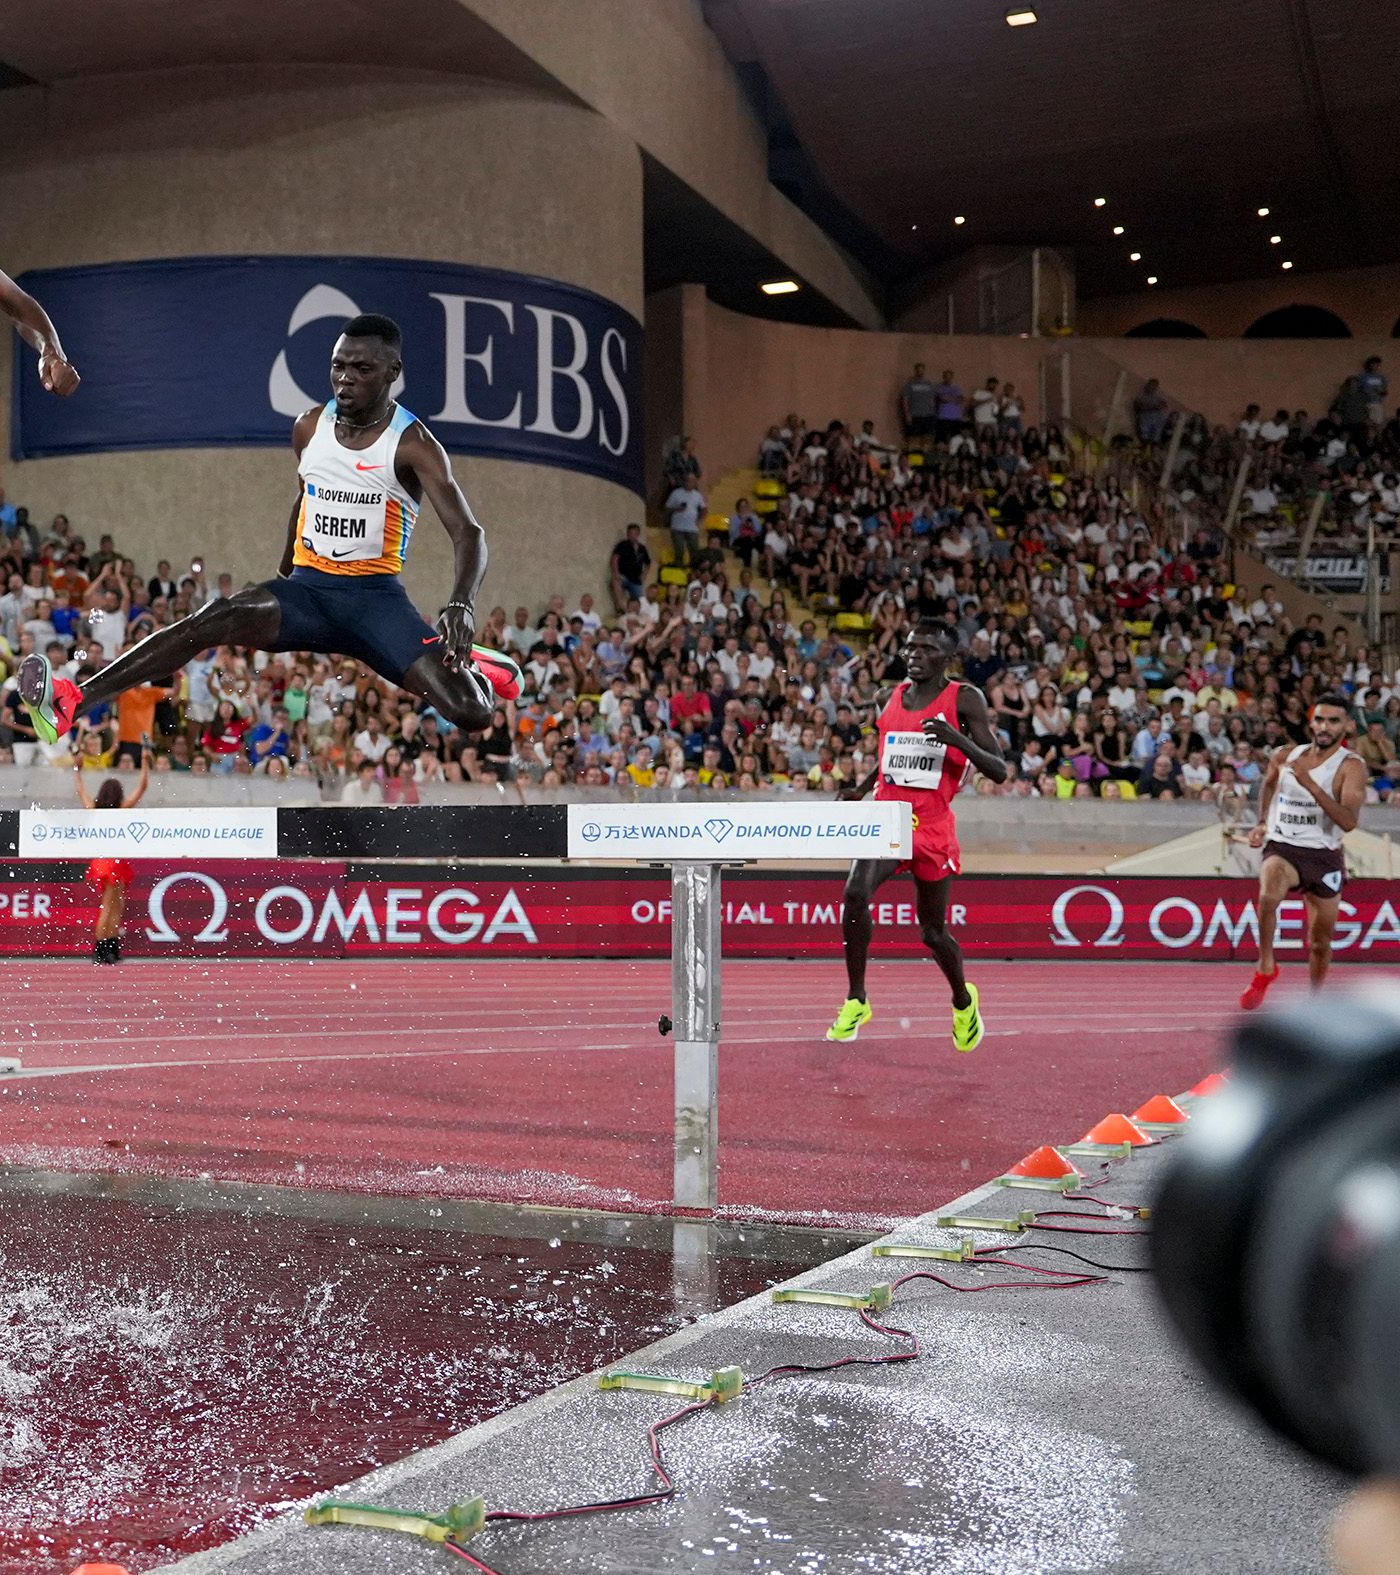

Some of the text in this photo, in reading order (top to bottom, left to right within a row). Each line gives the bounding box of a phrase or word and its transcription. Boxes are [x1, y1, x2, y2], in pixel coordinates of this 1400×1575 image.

[428, 291, 629, 456] EBS
[318, 487, 382, 505] SLOVENIJALES
[314, 513, 366, 538] SEREM
[888, 754, 935, 771] KIBIWOT
[78, 827, 126, 839] WANDA
[152, 827, 211, 839] DIAMOND
[214, 827, 264, 839] LEAGUE
[604, 824, 881, 839] 万达 WANDA DIAMOND LEAGUE
[255, 885, 539, 944] OMEGA
[631, 900, 967, 925] OFIAL TIMEER
